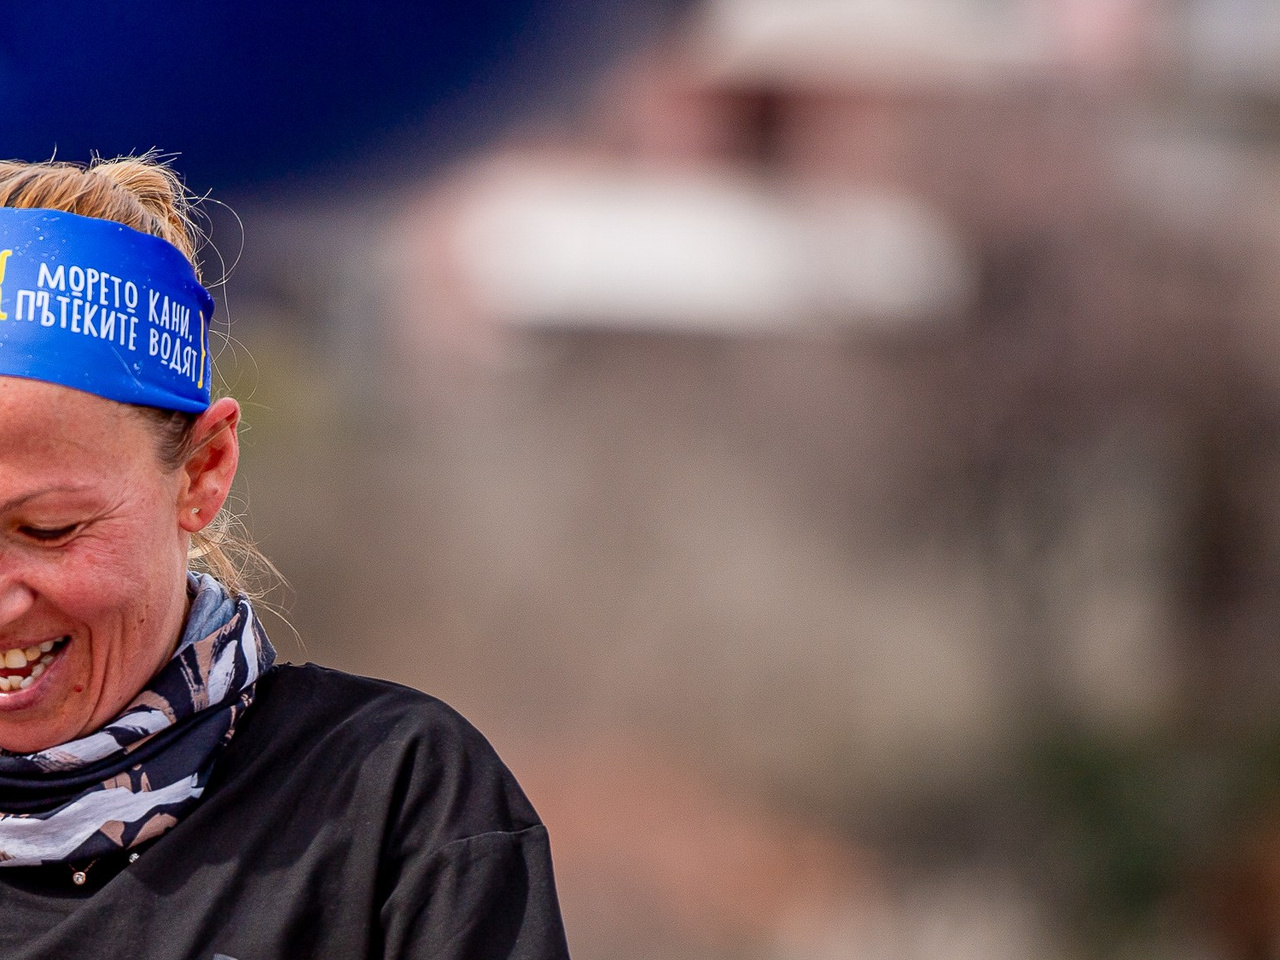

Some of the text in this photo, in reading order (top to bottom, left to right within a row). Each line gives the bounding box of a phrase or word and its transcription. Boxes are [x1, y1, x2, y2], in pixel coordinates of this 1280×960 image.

[15, 289, 198, 382] ПЪТЕКИТЕ ВОДЯТ
[37, 262, 194, 342] МОРЕТО КАНИ,
